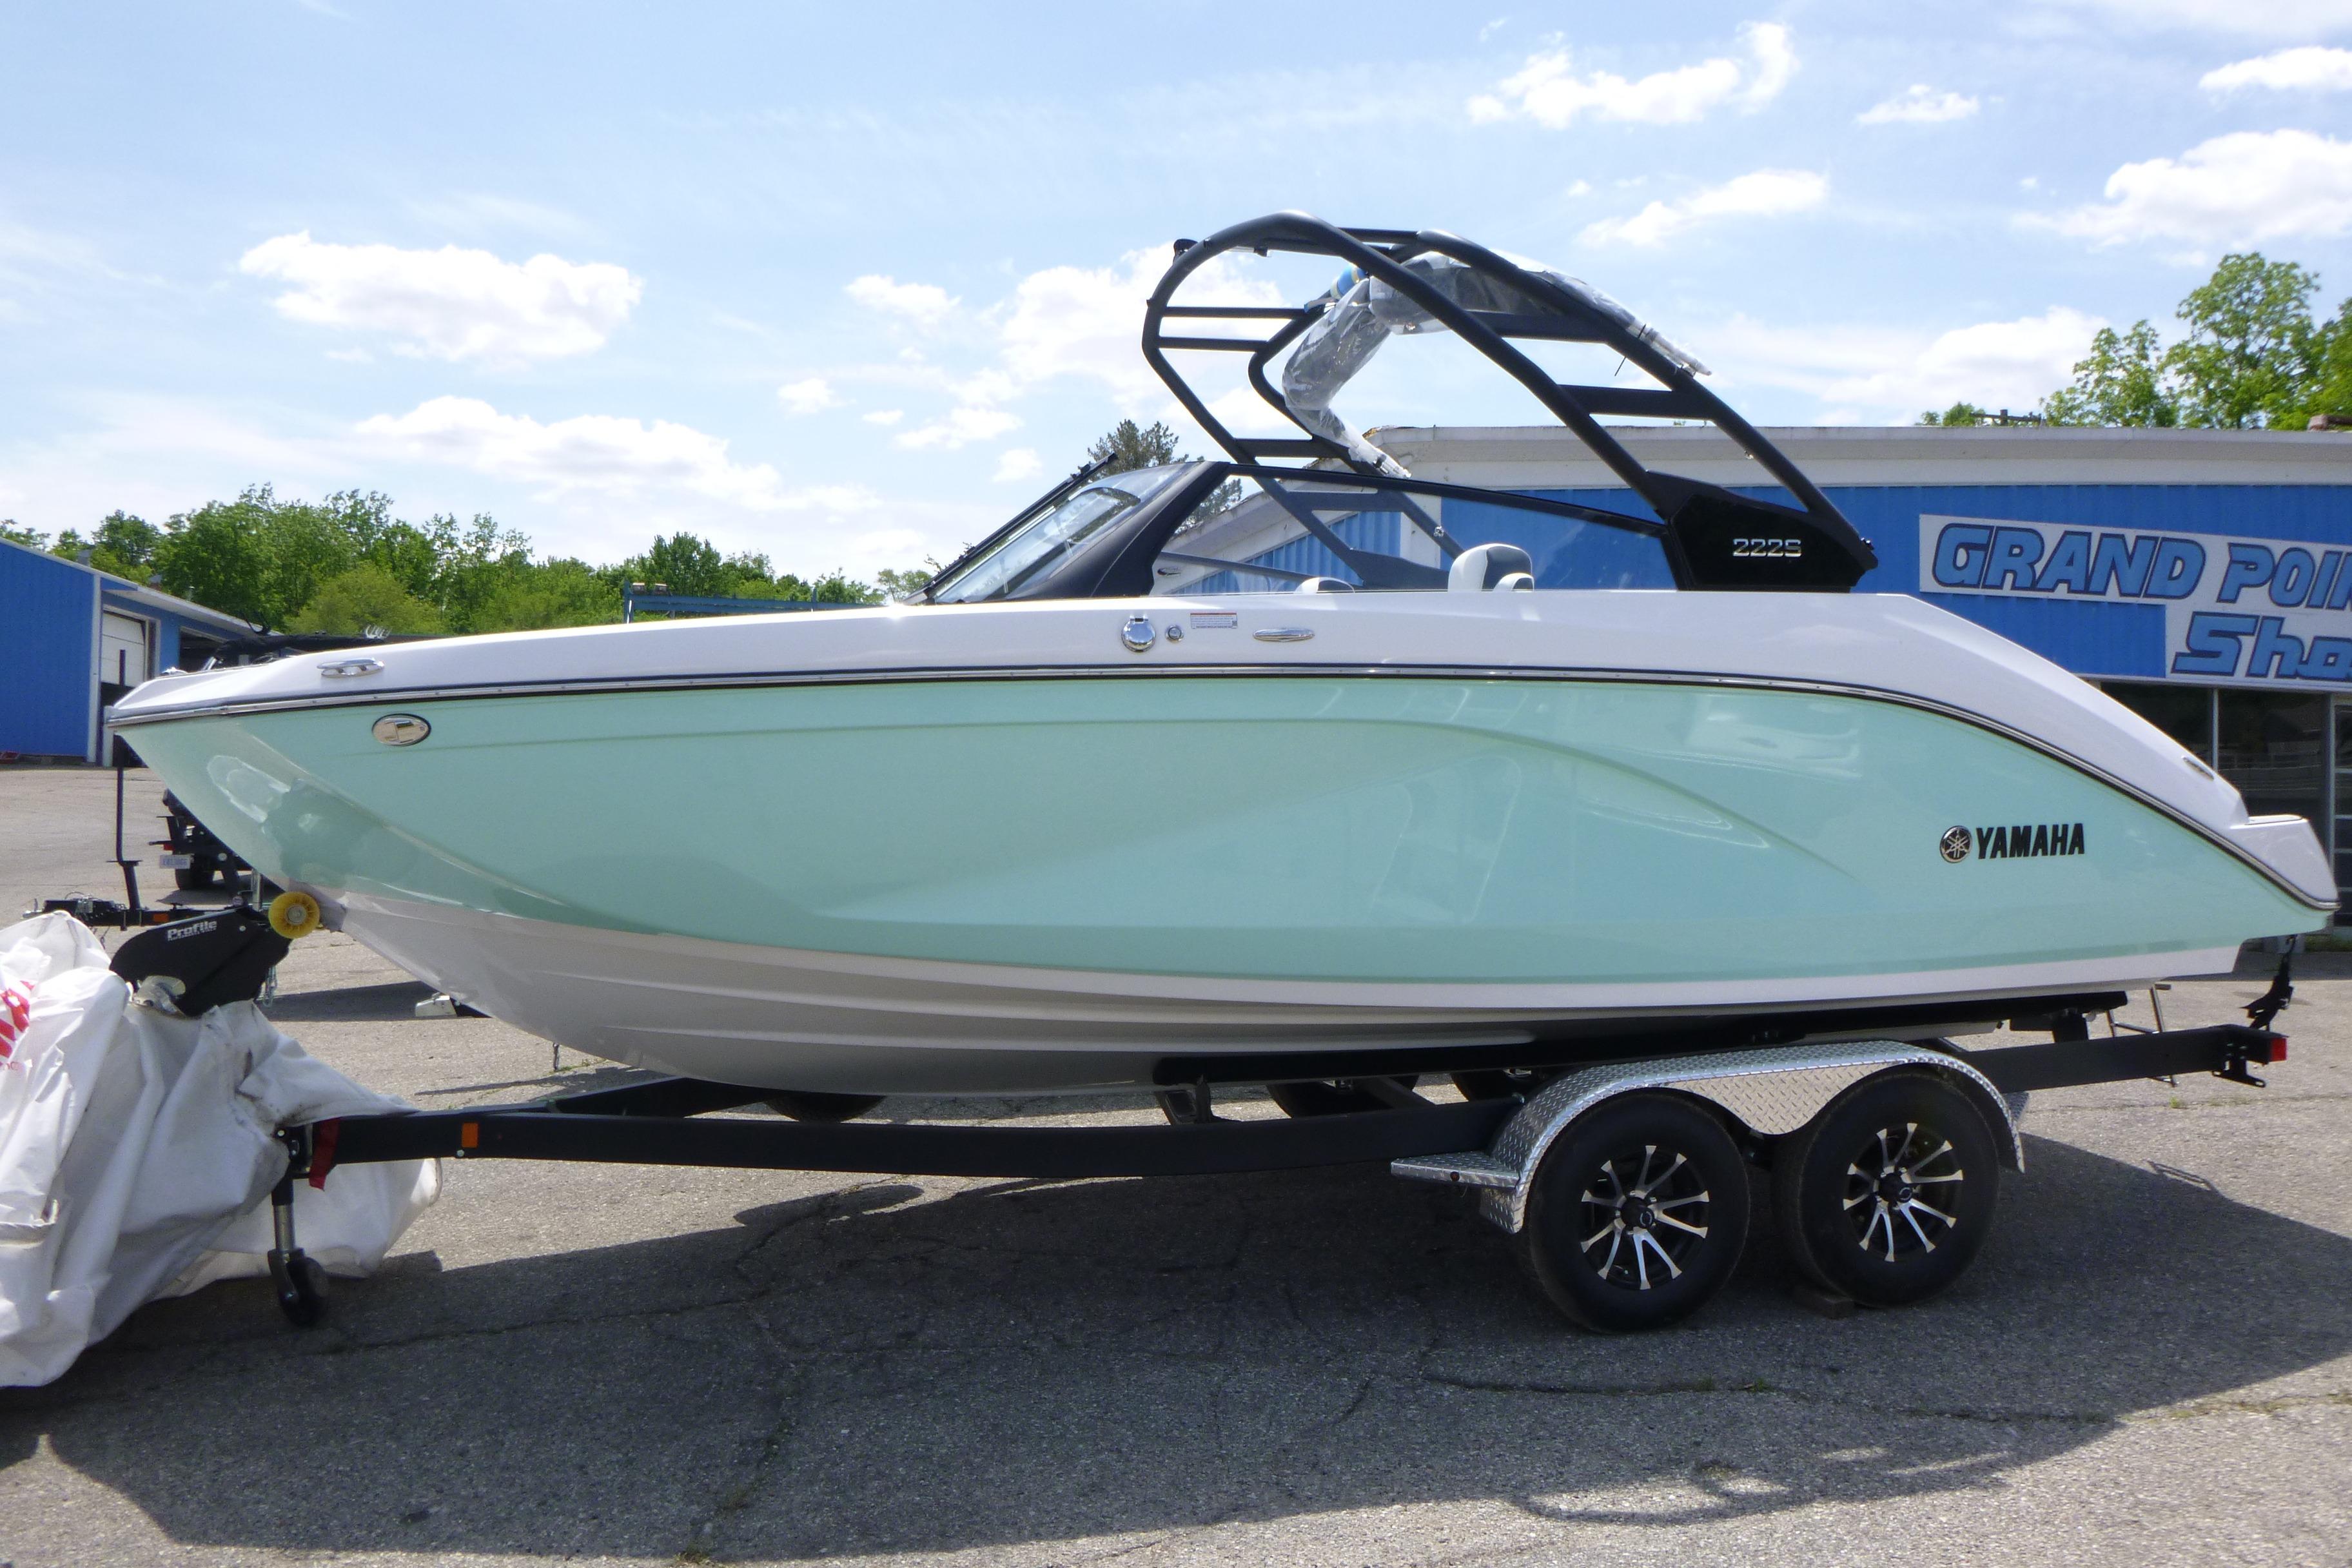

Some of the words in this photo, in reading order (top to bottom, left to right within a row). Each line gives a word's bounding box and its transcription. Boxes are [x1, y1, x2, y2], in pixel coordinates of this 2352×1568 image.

[1732, 538, 1802, 558] 222S
[1932, 522, 2206, 600] GRAND
[1975, 823, 2084, 859] YAMAHA
[168, 921, 217, 939] Profile
